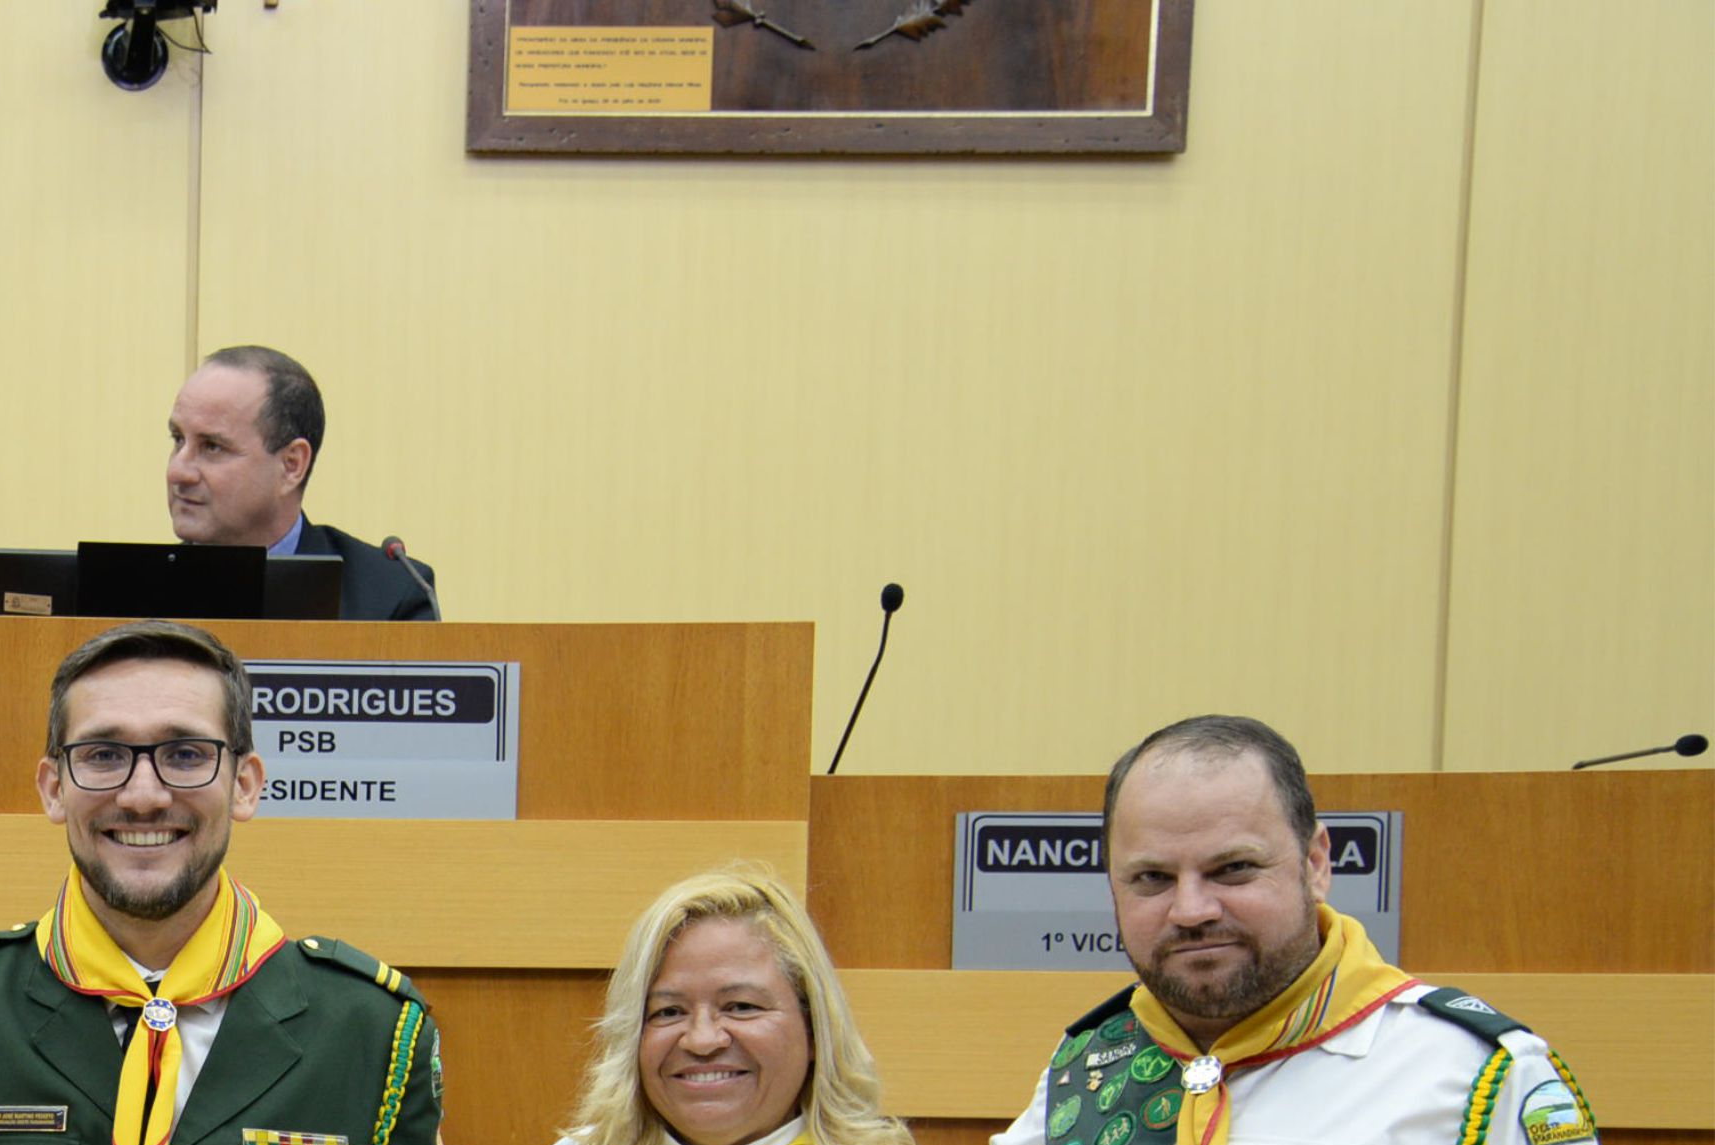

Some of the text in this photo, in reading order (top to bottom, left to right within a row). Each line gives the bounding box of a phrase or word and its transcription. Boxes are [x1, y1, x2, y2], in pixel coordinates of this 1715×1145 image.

[252, 687, 456, 716] RODRIGUES
[279, 731, 336, 752] PSB
[259, 779, 396, 801] SIDENTE
[987, 839, 1099, 867] NANCI
[1041, 932, 1064, 952] 1º
